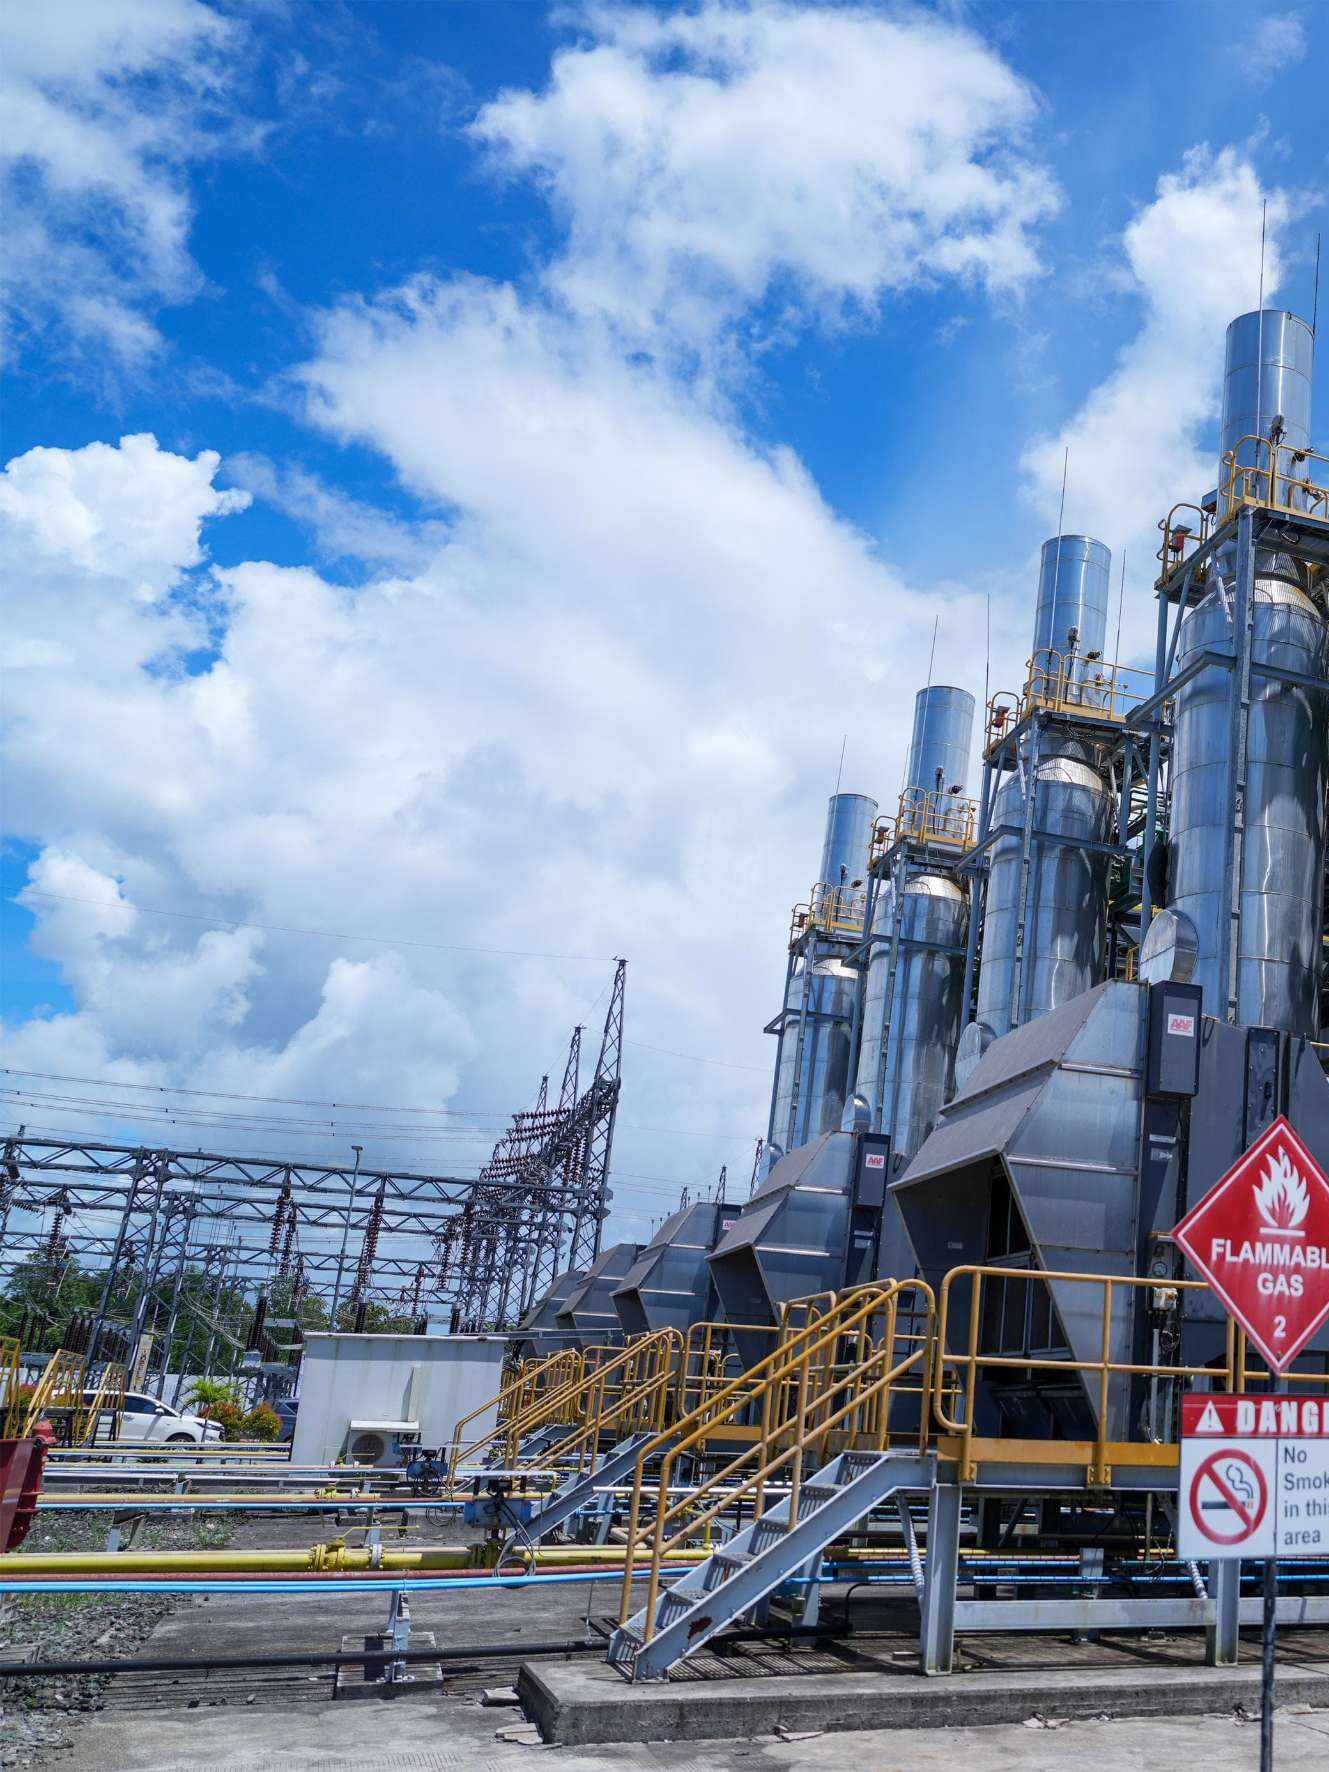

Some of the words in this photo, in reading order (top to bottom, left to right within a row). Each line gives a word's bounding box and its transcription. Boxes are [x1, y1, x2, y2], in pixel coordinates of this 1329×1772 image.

[1257, 1272, 1304, 1297] GAS
[1273, 1315, 1287, 1338] 2
[1283, 1446, 1308, 1464] No
[1284, 1500, 1300, 1518] in
[1283, 1529, 1321, 1545] area
